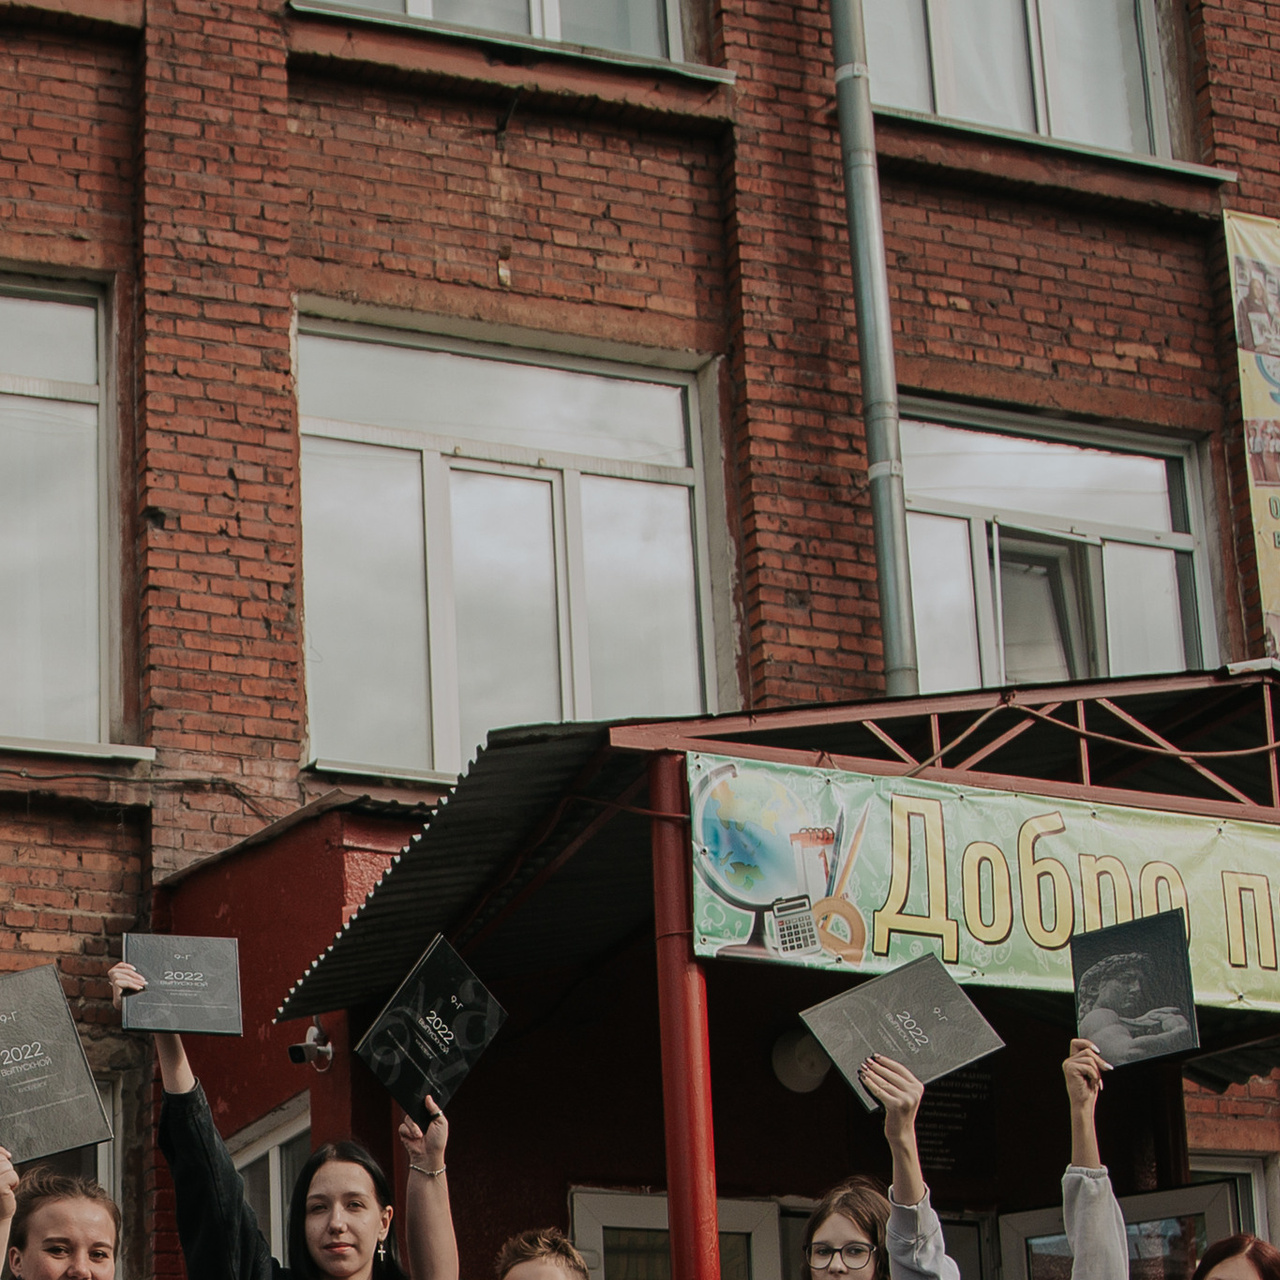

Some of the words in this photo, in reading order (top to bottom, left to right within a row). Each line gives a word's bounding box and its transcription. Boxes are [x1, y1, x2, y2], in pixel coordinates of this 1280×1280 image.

[163, 970, 204, 981] 2022
[426, 1010, 454, 1045] 2022
[896, 1010, 929, 1047] 2022
[0, 1041, 44, 1066] 2022
